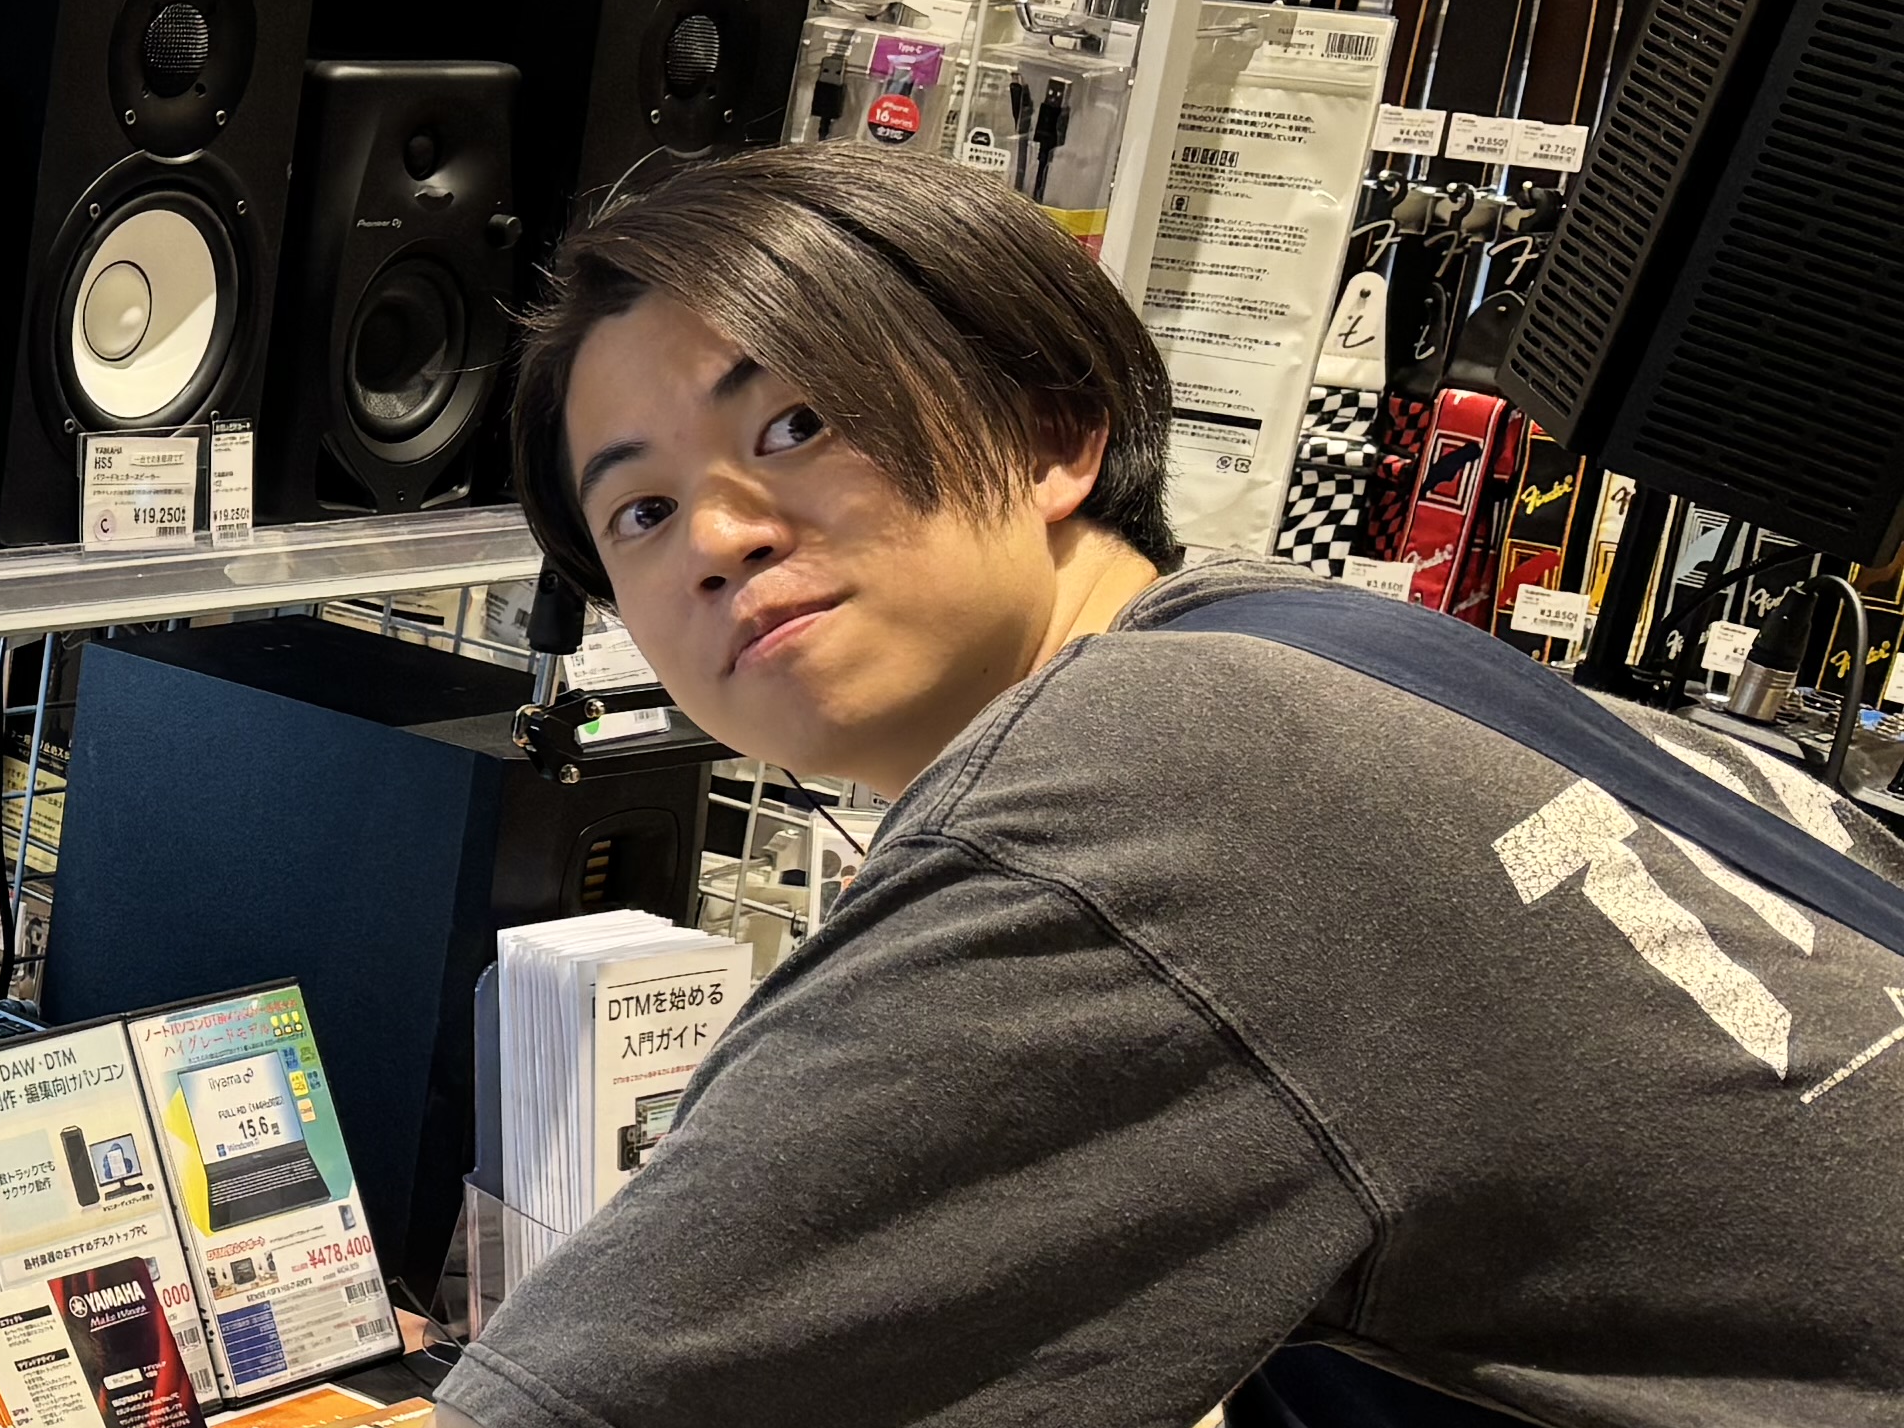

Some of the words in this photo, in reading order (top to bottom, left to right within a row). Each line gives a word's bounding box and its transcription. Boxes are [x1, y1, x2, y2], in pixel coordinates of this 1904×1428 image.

[94, 456, 112, 470] HS5
[1521, 476, 1573, 512] Fender
[134, 506, 183, 523] ¥19,250
[606, 983, 724, 1023] DTMを始める
[622, 1023, 708, 1058] 入門ガイド
[308, 1238, 370, 1266] ¥478,400
[89, 1280, 145, 1319] YAMAHA
